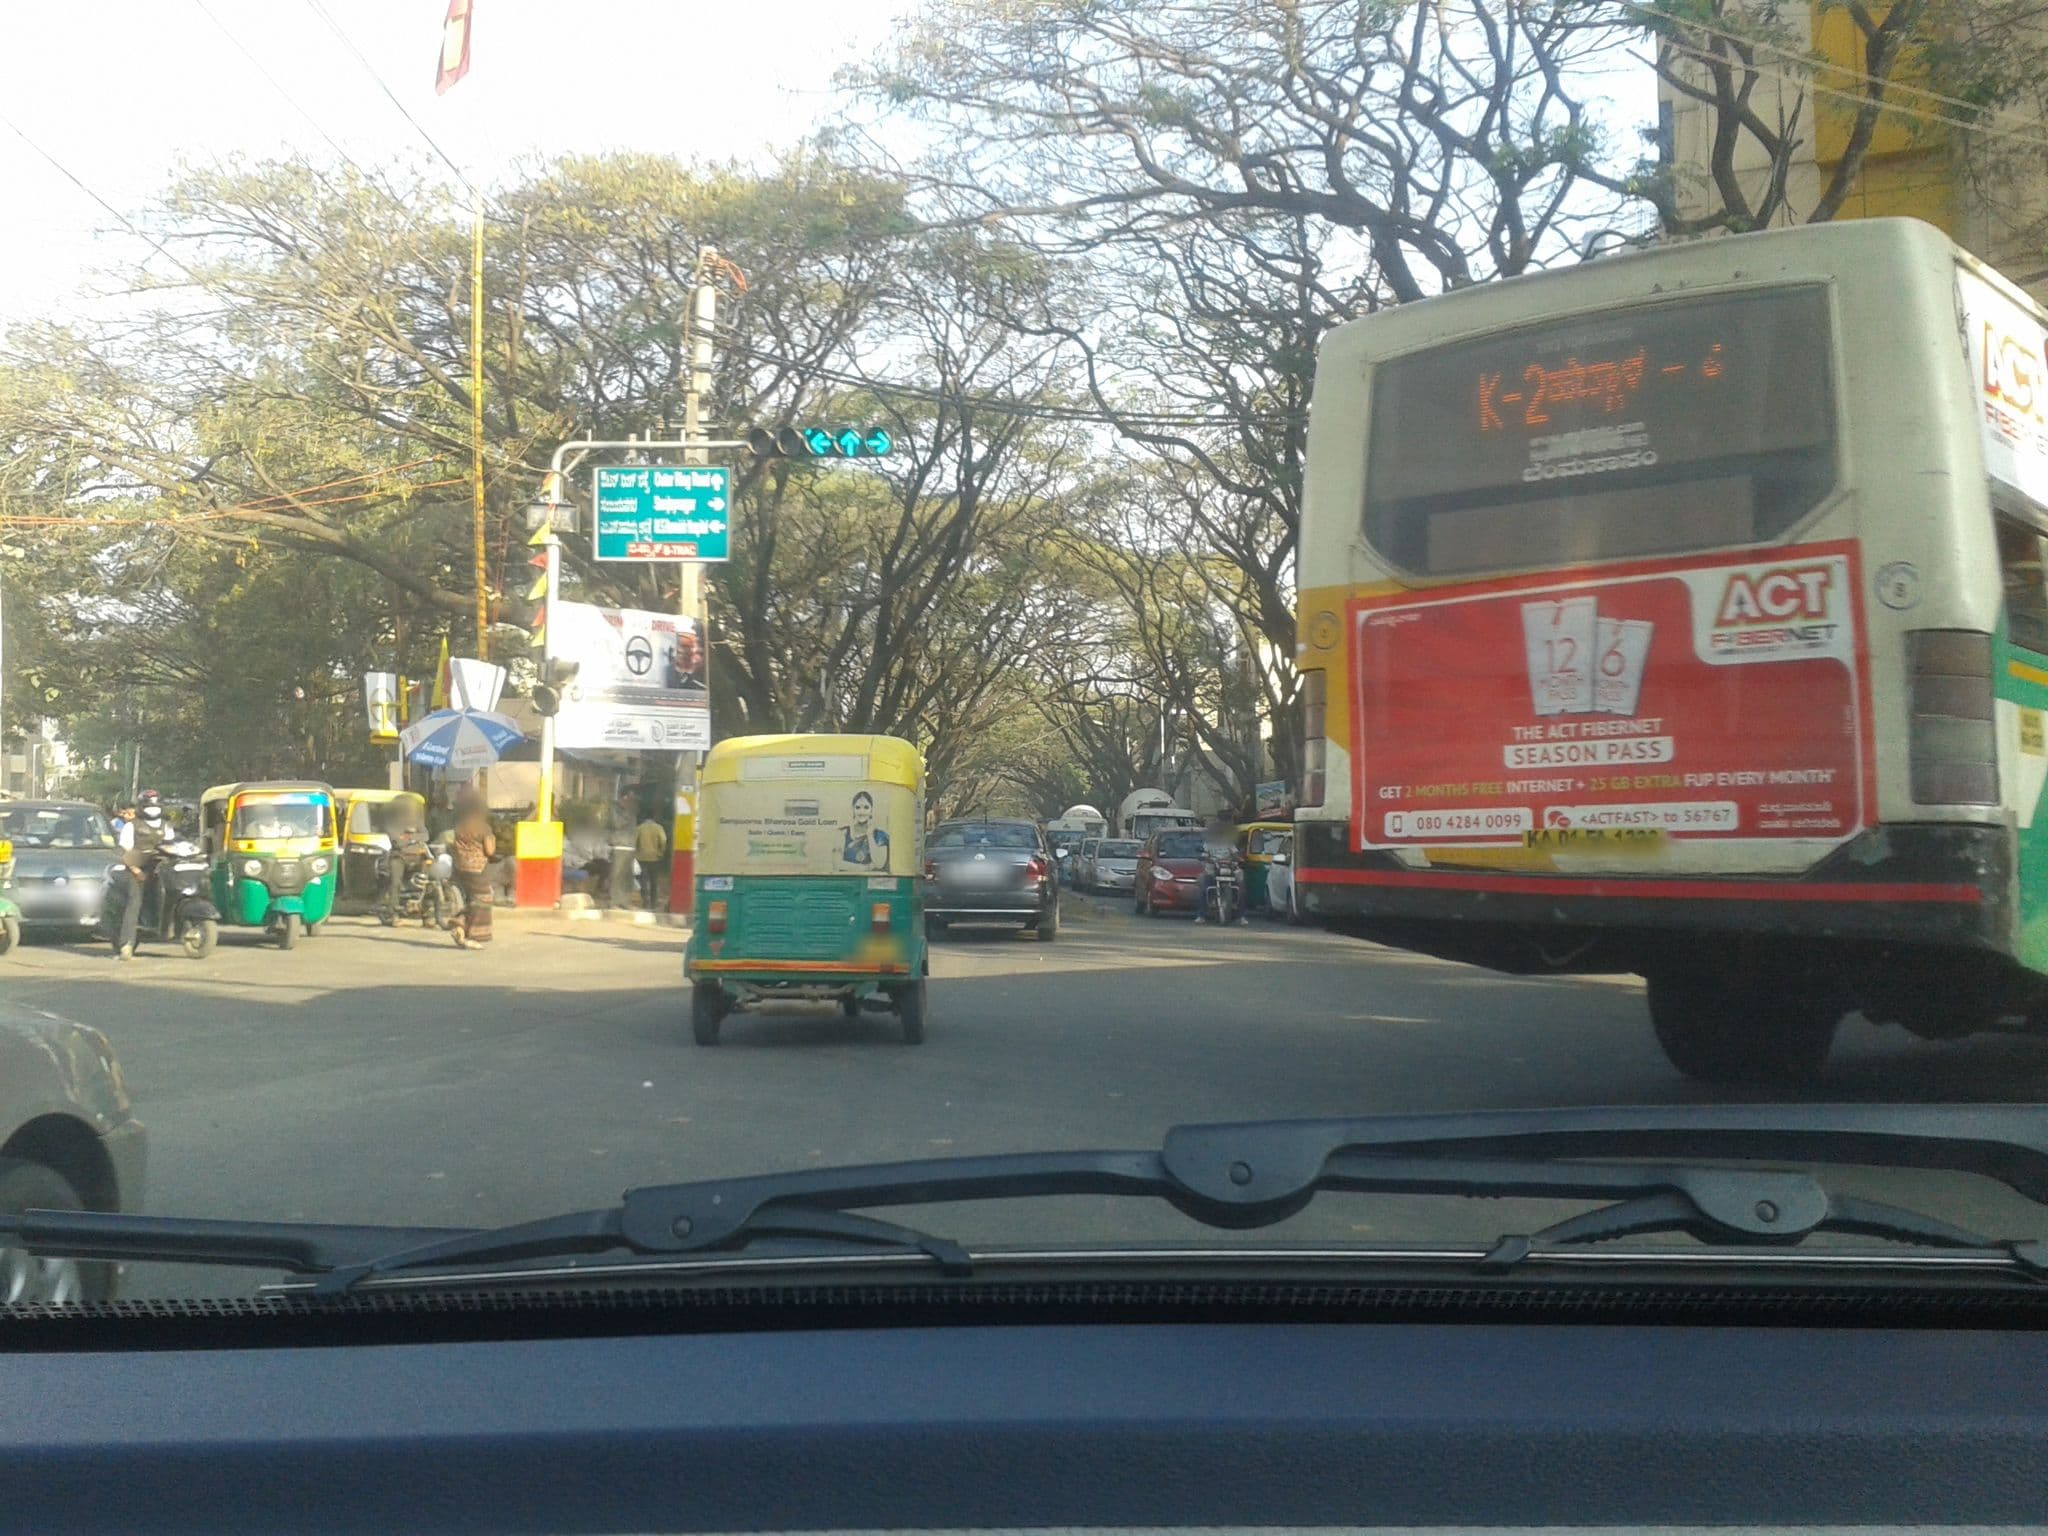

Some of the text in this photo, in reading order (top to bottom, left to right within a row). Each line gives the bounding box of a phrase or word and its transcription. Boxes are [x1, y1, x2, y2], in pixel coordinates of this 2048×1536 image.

[1716, 565, 1832, 627] ACT
[1544, 637, 1577, 674] 12
[1601, 638, 1626, 677] 6
[1512, 718, 1663, 740] THE ACT FIBERNET
[1514, 740, 1662, 766] SEASON PASS
[1379, 786, 1402, 799] GET
[1405, 785, 1412, 797] 2
[1415, 783, 1468, 797] MONTHS
[1472, 782, 1503, 796] FREE
[1507, 779, 1573, 794] INTERNET
[1634, 775, 1682, 789] EXTRA
[1717, 771, 1765, 786] EVERY
[1416, 813, 1522, 831] 080 4284 0099
[1663, 811, 1678, 823] to
[1684, 809, 1731, 823] 56767
